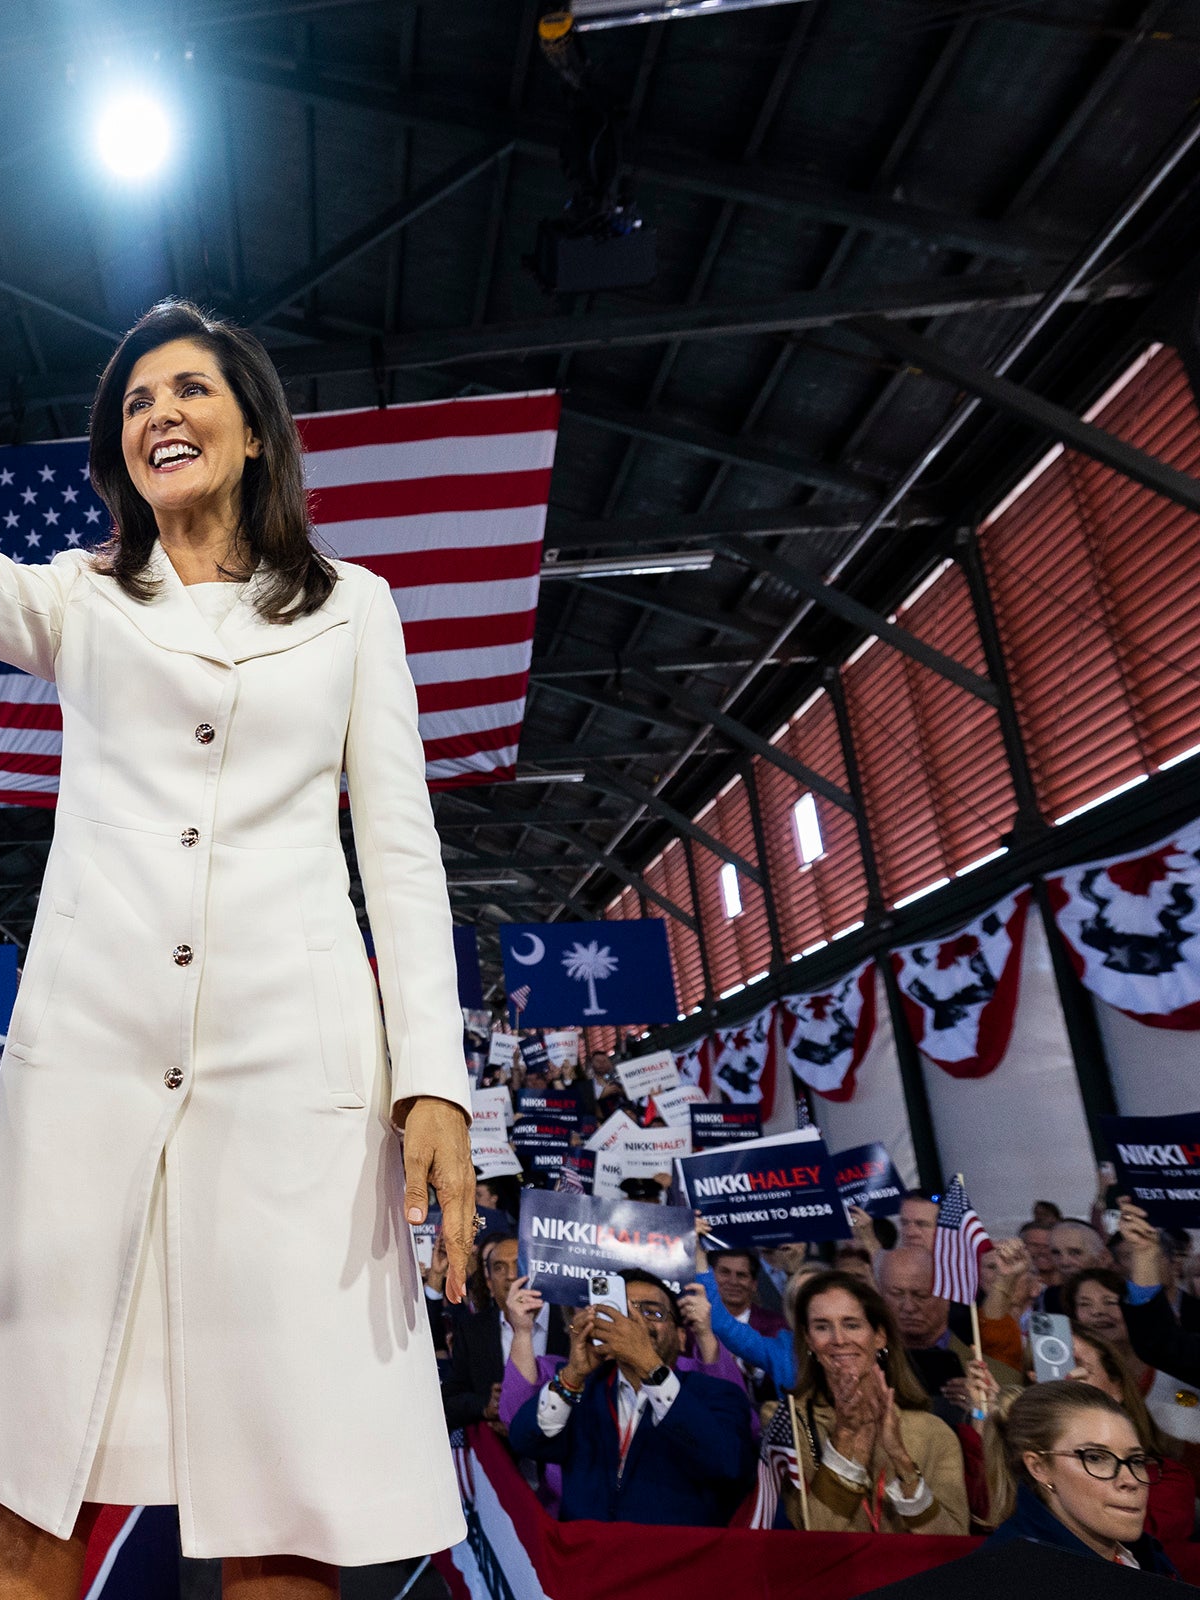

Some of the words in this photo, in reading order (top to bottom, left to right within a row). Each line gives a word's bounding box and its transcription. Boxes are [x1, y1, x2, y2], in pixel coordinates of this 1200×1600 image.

[729, 1209, 770, 1224] NIKKI
[770, 1207, 789, 1220] TO
[789, 1203, 834, 1218] 48324
[531, 1259, 560, 1275] TEXT
